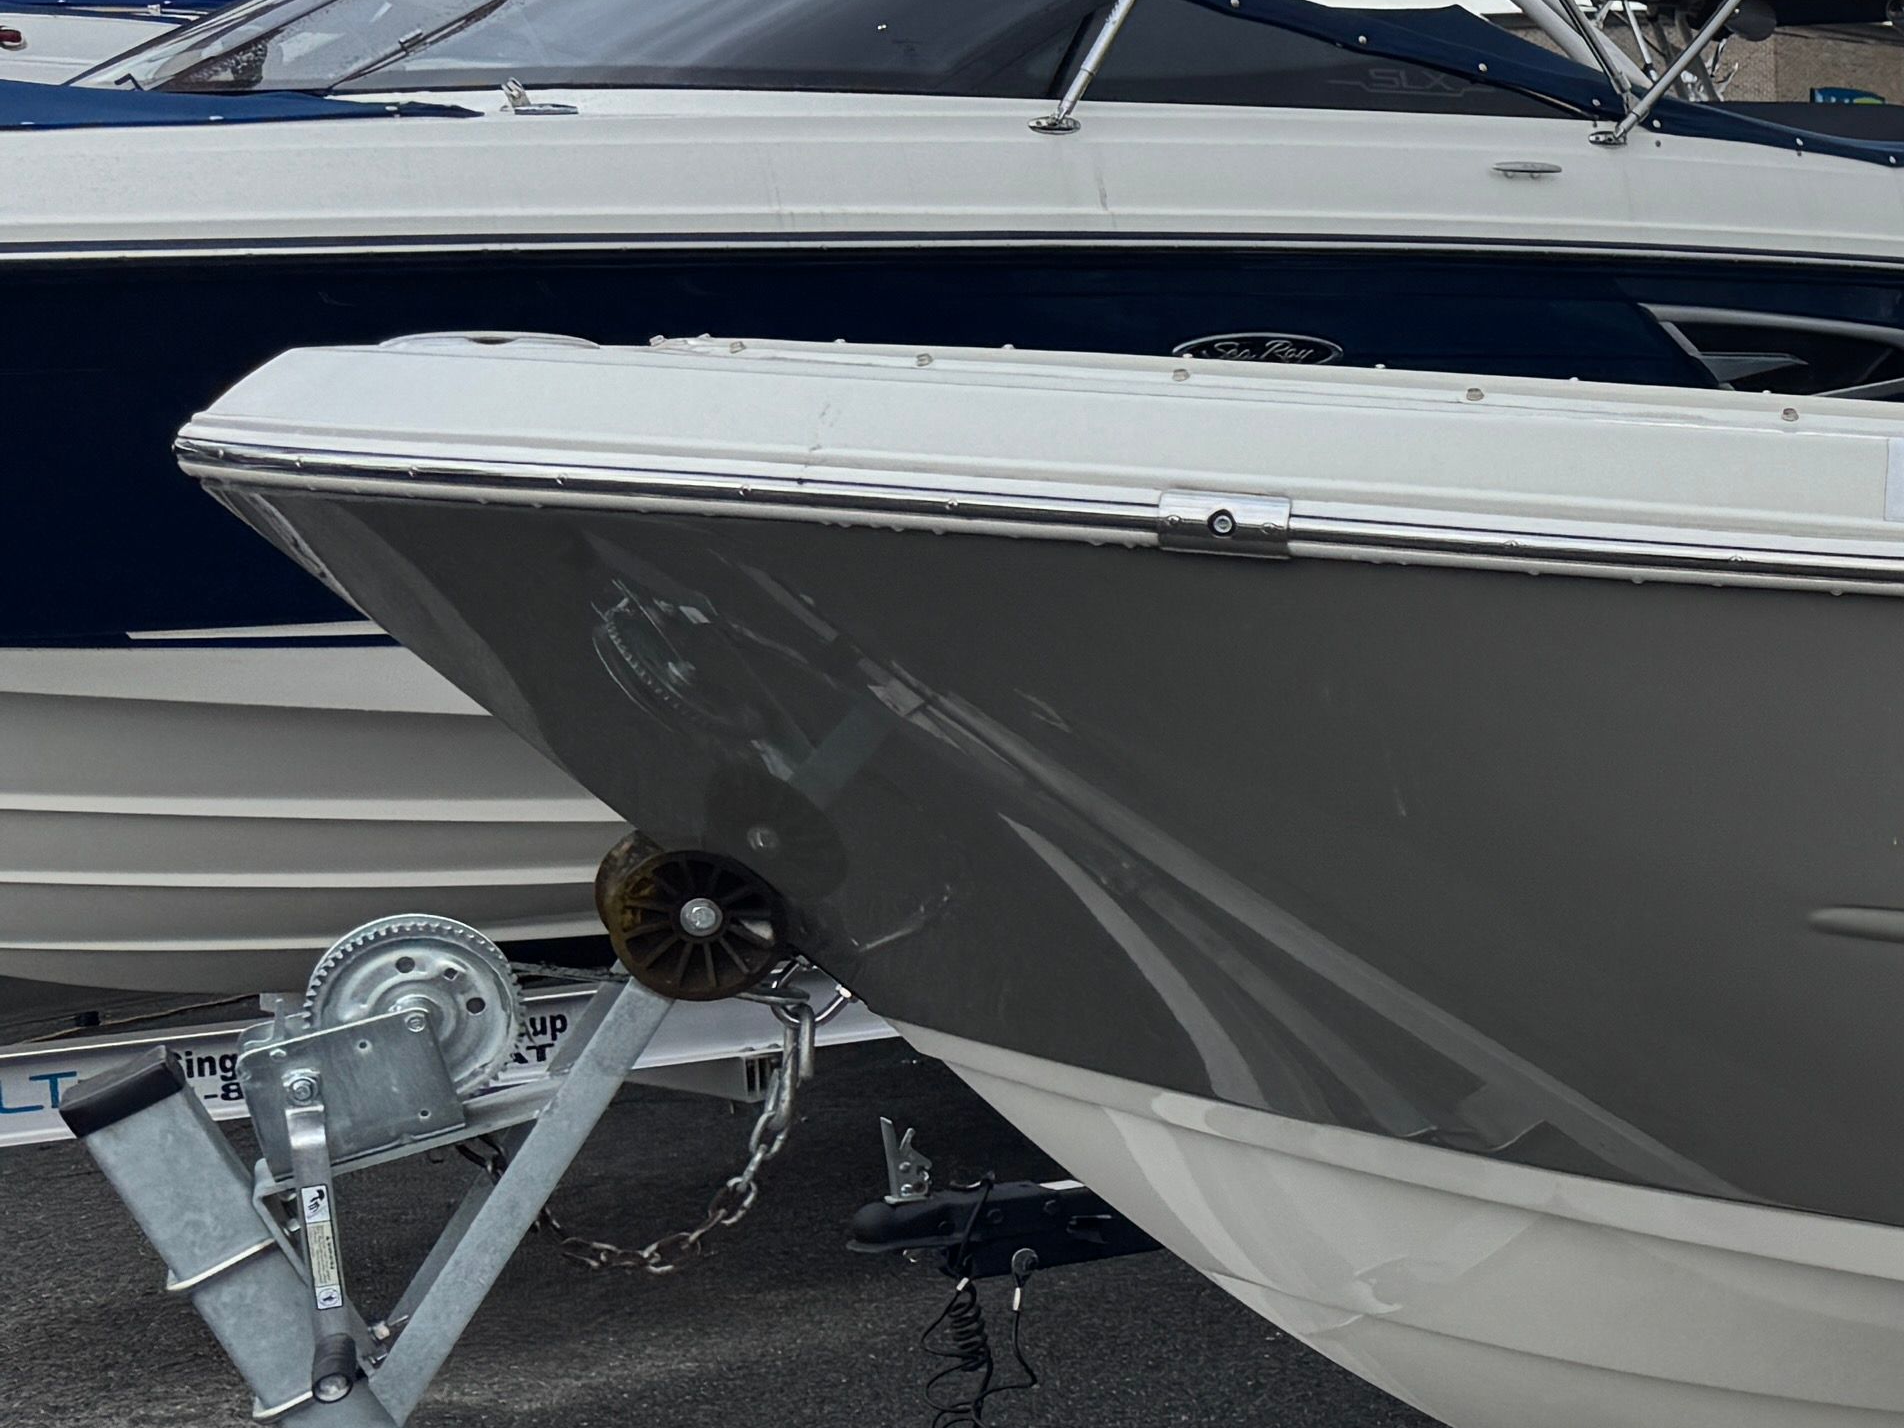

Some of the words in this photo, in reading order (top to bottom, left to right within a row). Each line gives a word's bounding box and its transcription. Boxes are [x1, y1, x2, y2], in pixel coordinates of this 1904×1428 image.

[1369, 68, 1457, 91] SLX
[1202, 341, 1257, 361] Sea
[1259, 339, 1314, 363] Ray
